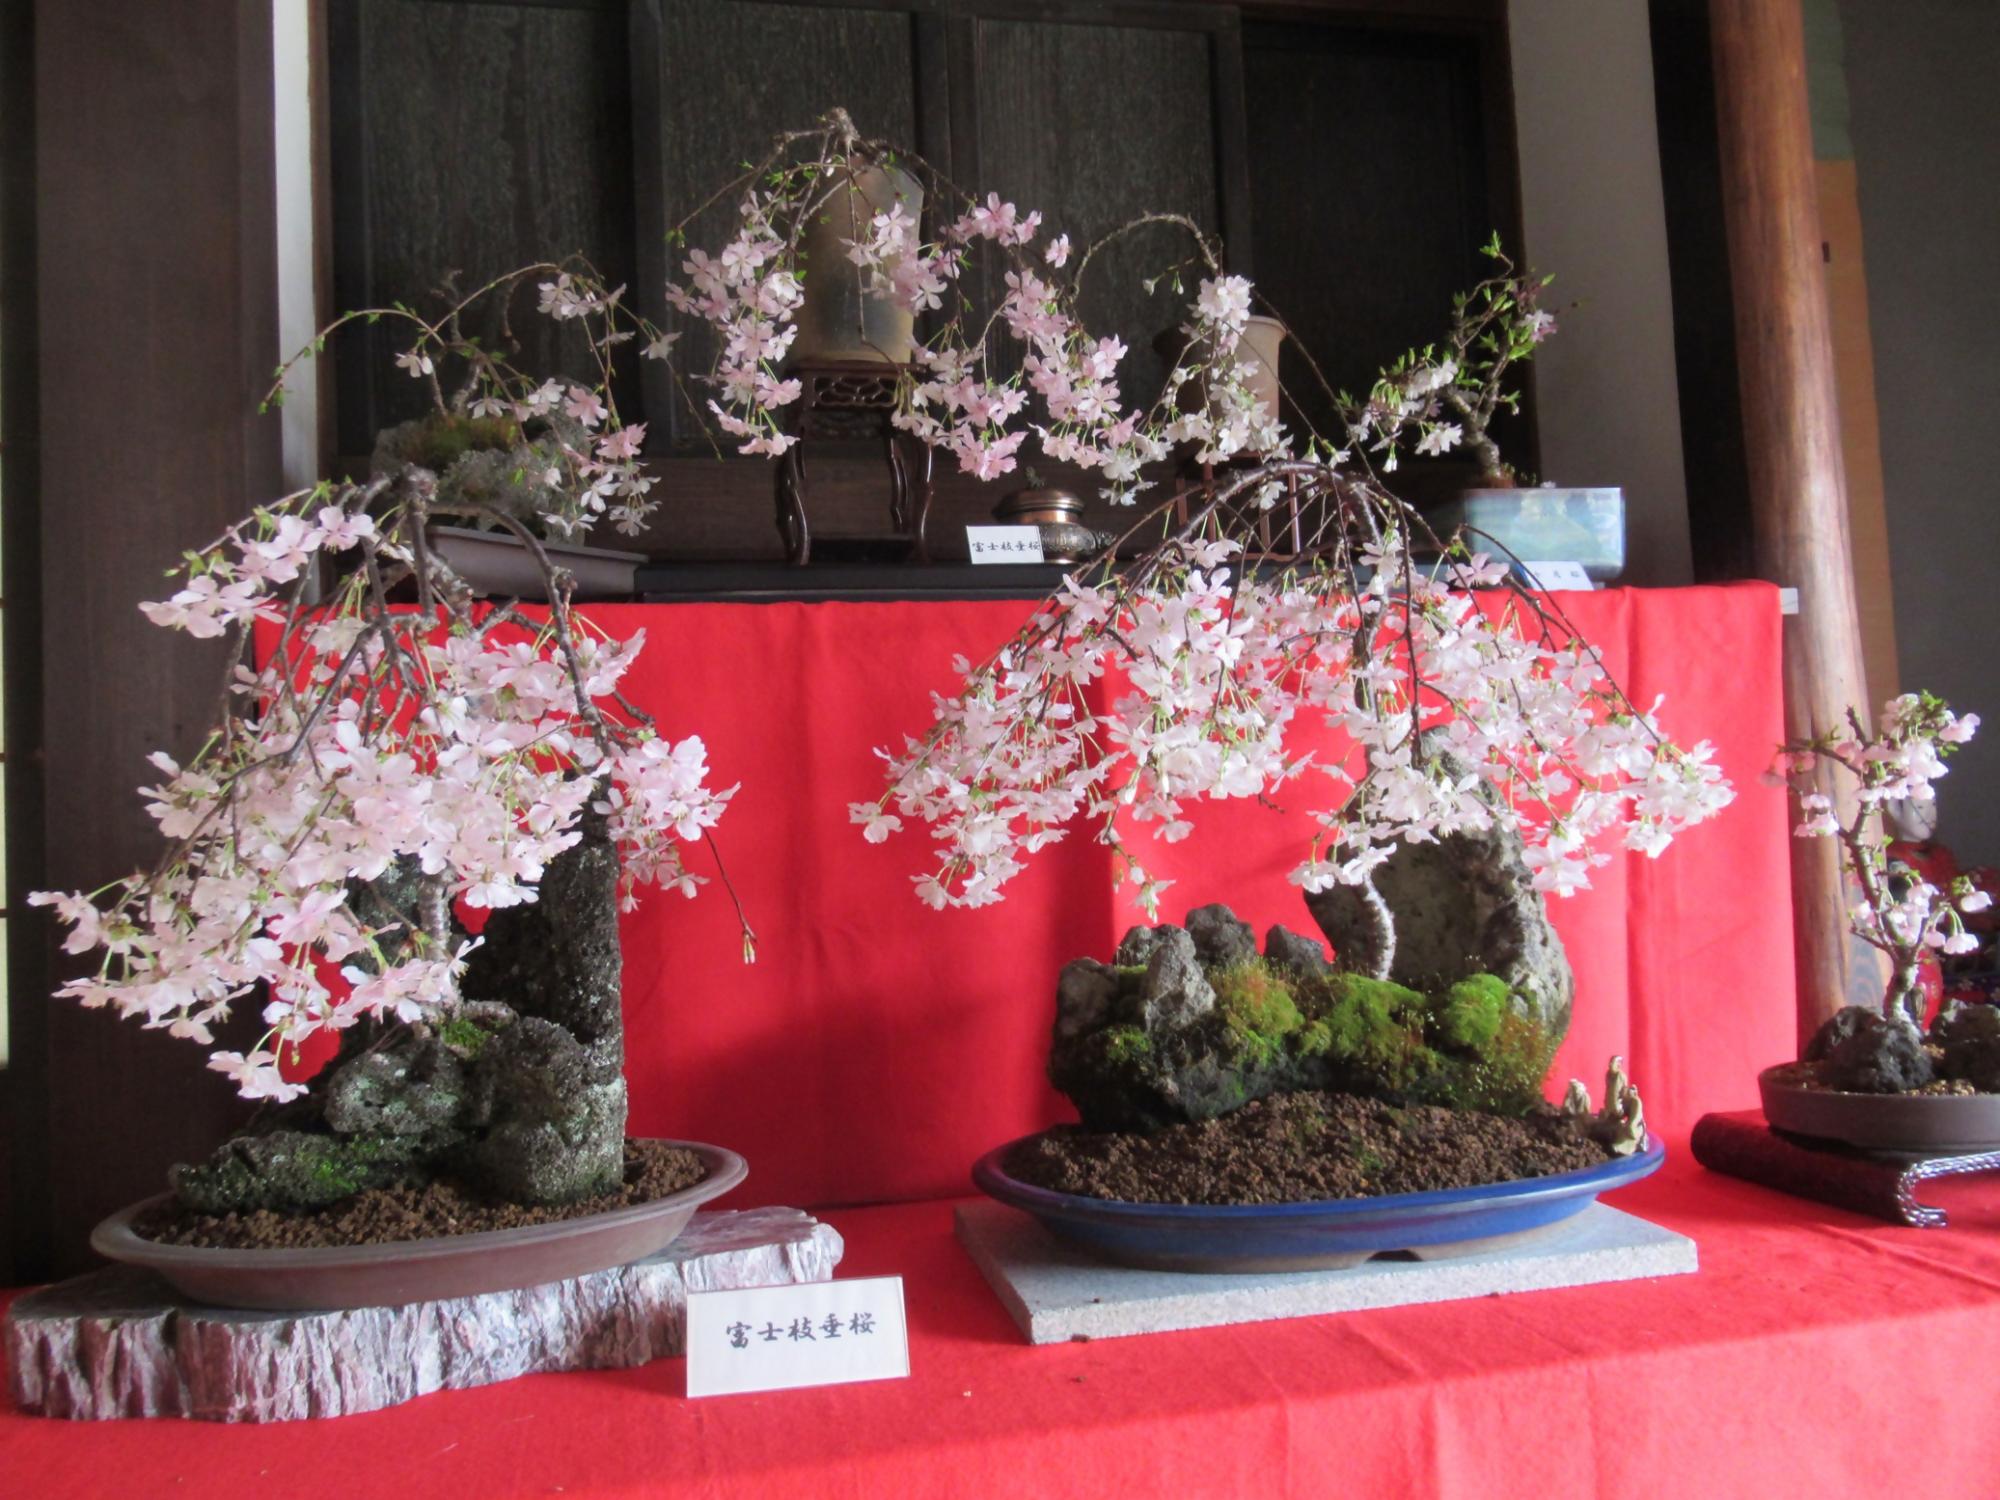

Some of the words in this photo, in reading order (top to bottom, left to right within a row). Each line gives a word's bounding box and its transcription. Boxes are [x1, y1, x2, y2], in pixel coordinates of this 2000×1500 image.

[726, 1312, 876, 1348] 富士枝垂桜
